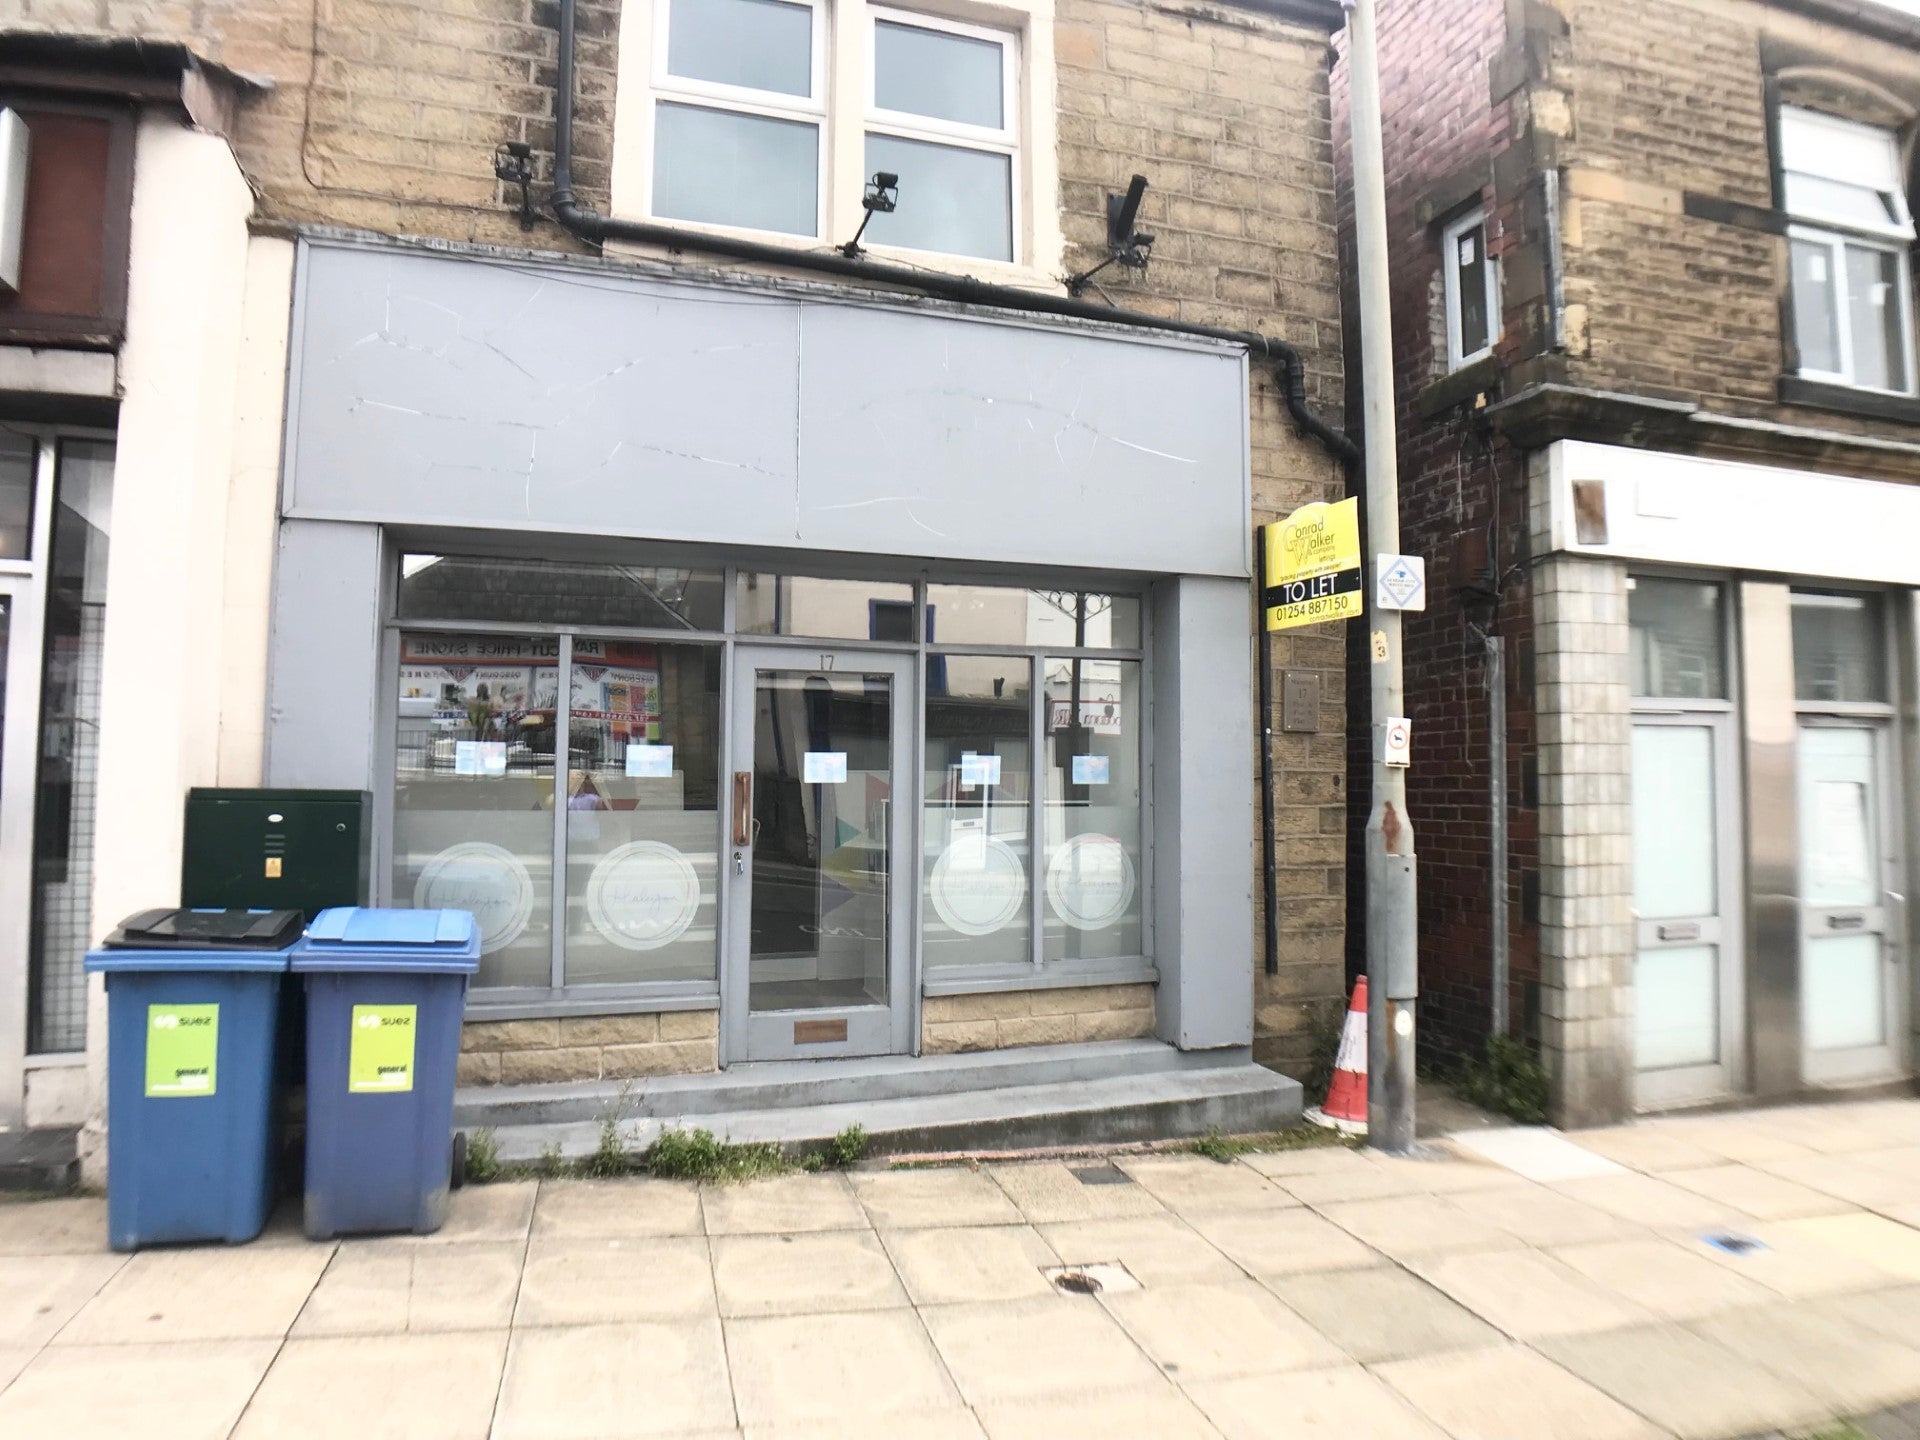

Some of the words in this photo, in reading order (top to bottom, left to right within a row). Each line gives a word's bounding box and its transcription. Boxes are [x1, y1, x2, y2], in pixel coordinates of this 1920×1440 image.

[1283, 581, 1306, 603] TO
[1311, 573, 1338, 598] LET
[1276, 604, 1306, 621] 01254
[1308, 595, 1348, 615] 887150
[820, 654, 834, 671] 17
[179, 1016, 212, 1026] suez
[381, 1017, 411, 1026] suez
